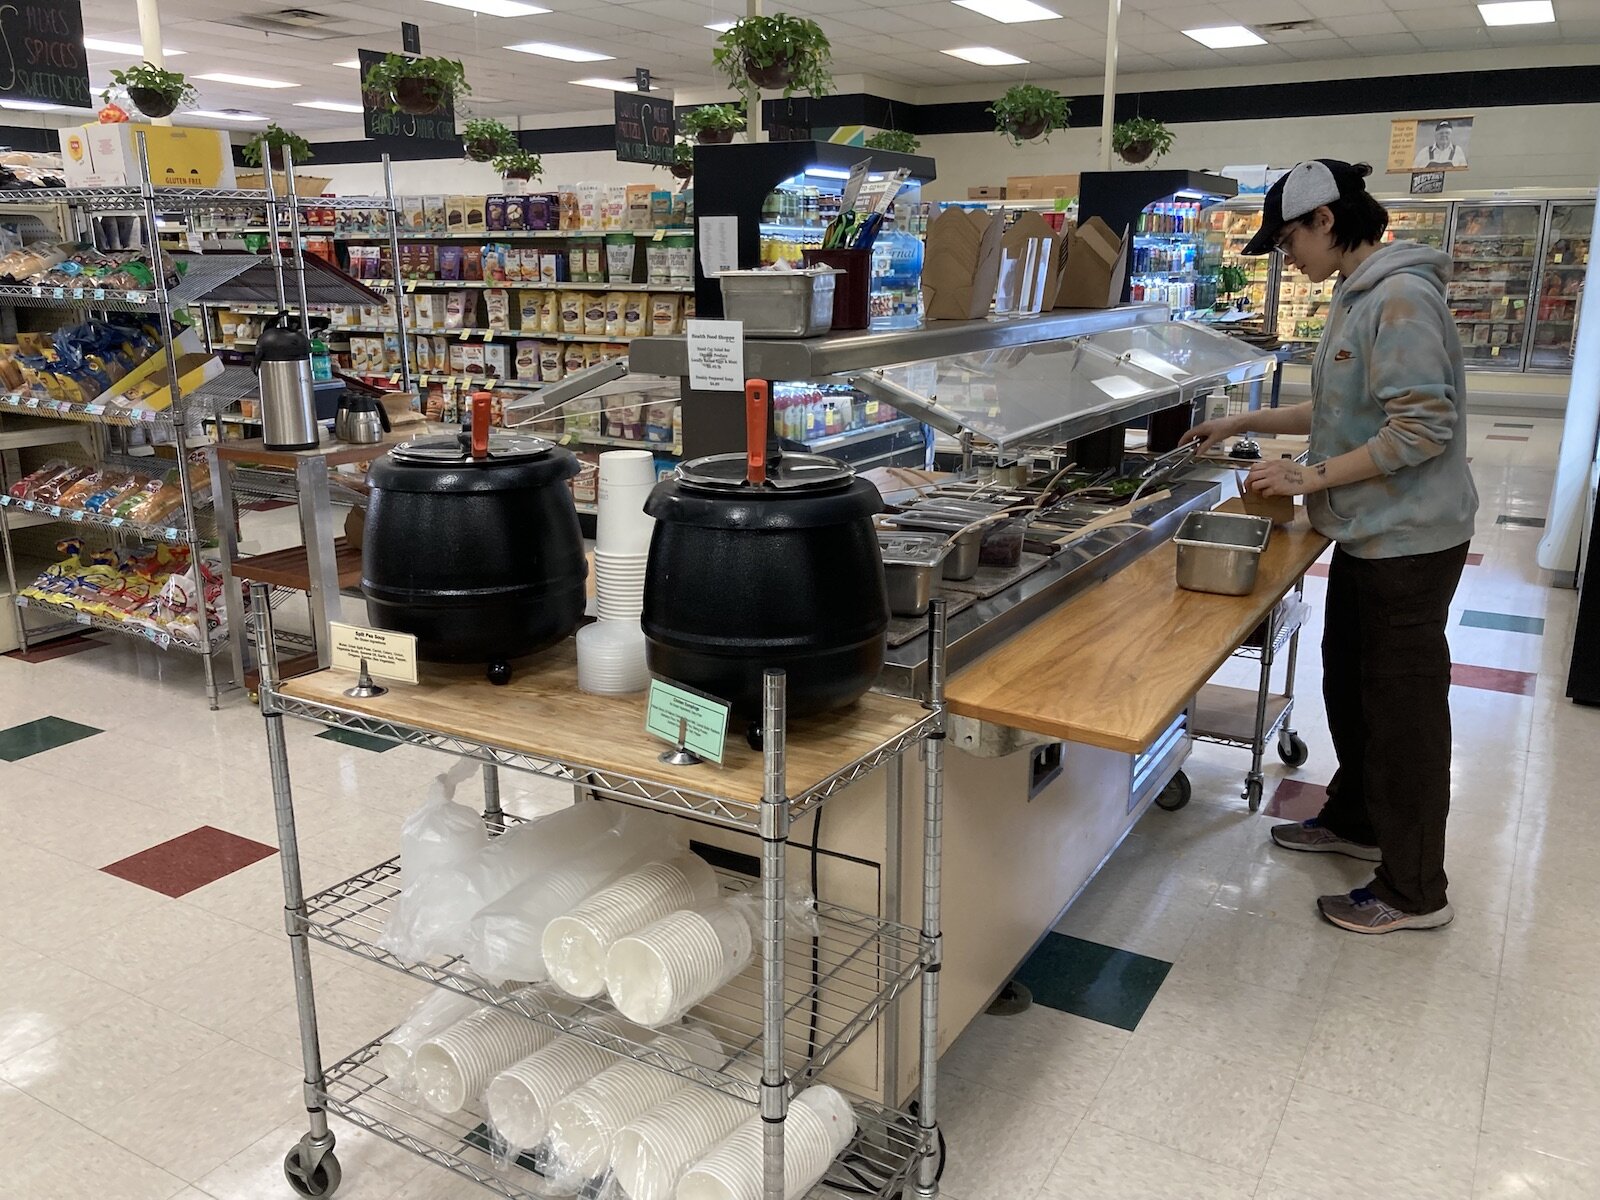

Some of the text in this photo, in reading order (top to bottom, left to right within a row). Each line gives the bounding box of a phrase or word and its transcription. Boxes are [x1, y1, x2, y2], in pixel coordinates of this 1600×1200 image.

[26, 5, 70, 36] MIXES
[24, 37, 78, 70] SPICES
[16, 68, 91, 103] SWEETENERS
[640, 71, 648, 88] 5
